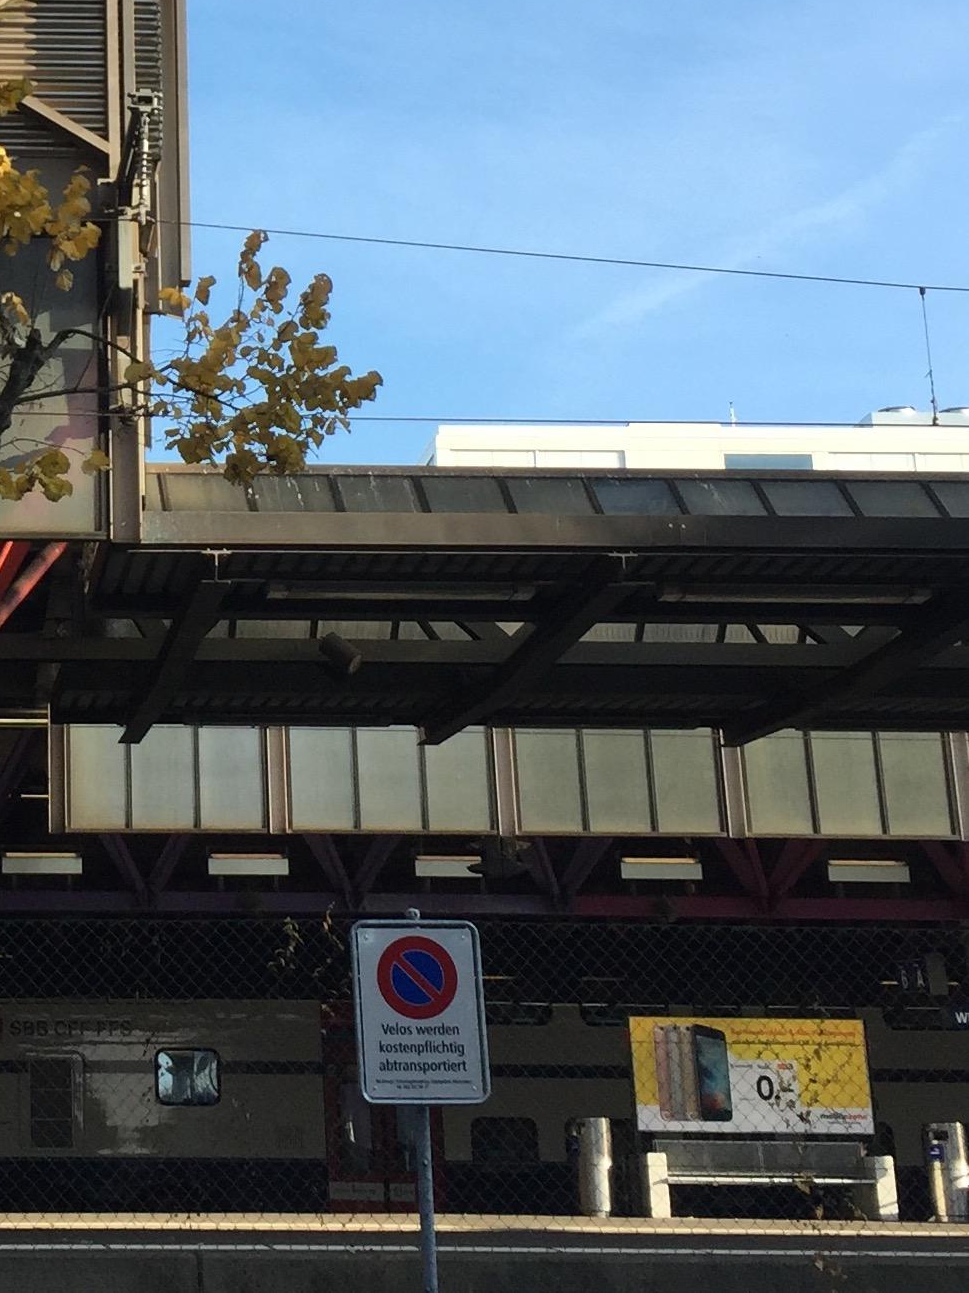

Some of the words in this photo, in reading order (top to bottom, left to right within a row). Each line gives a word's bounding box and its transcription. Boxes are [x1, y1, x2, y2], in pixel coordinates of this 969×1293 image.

[955, 1012, 969, 1024] W
[10, 1020, 49, 1037] SBB
[382, 1022, 413, 1035] Velos
[416, 1022, 460, 1035] werden
[379, 1040, 465, 1057] kostenpflichtig
[379, 1059, 467, 1075] abtransportiert
